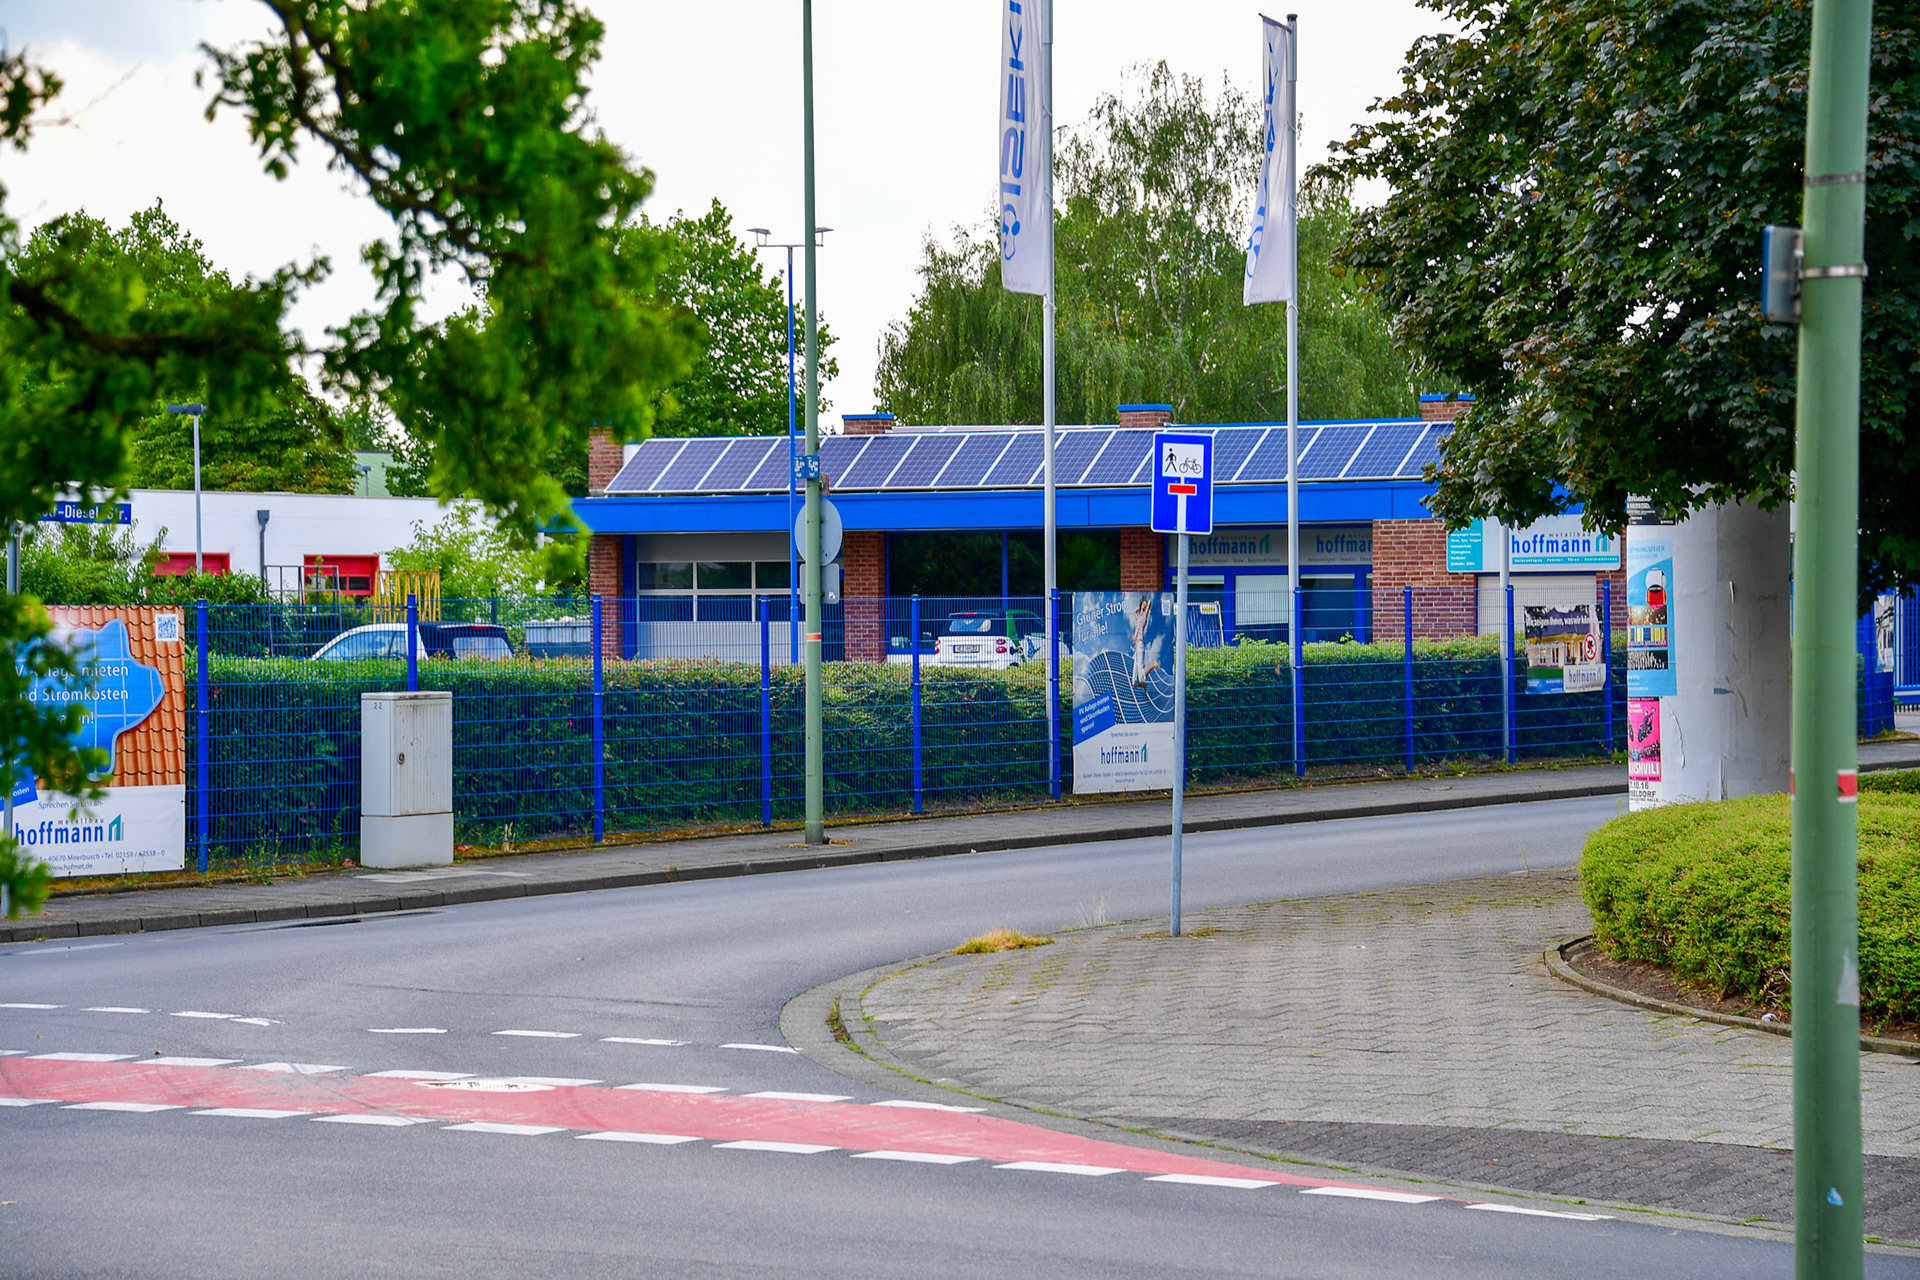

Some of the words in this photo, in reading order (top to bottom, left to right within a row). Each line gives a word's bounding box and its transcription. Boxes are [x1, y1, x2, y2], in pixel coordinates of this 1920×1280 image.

[1189, 536, 1257, 555] hoffmann
[1511, 534, 1591, 554] hoffmann
[81, 663, 129, 677] mieten
[1568, 669, 1597, 684] hoffmann
[19, 687, 38, 702] nd
[42, 686, 129, 702] Stromkosten
[373, 701, 383, 710] 22
[1100, 746, 1140, 764] hoffmann
[38, 800, 69, 810] Sprechen
[58, 817, 104, 826] metallbau
[15, 820, 104, 846] hoffmann
[48, 854, 66, 863] 40670
[67, 852, 100, 862] Meerbusch
[105, 851, 115, 860] Tel.
[115, 850, 134, 859] 02159
